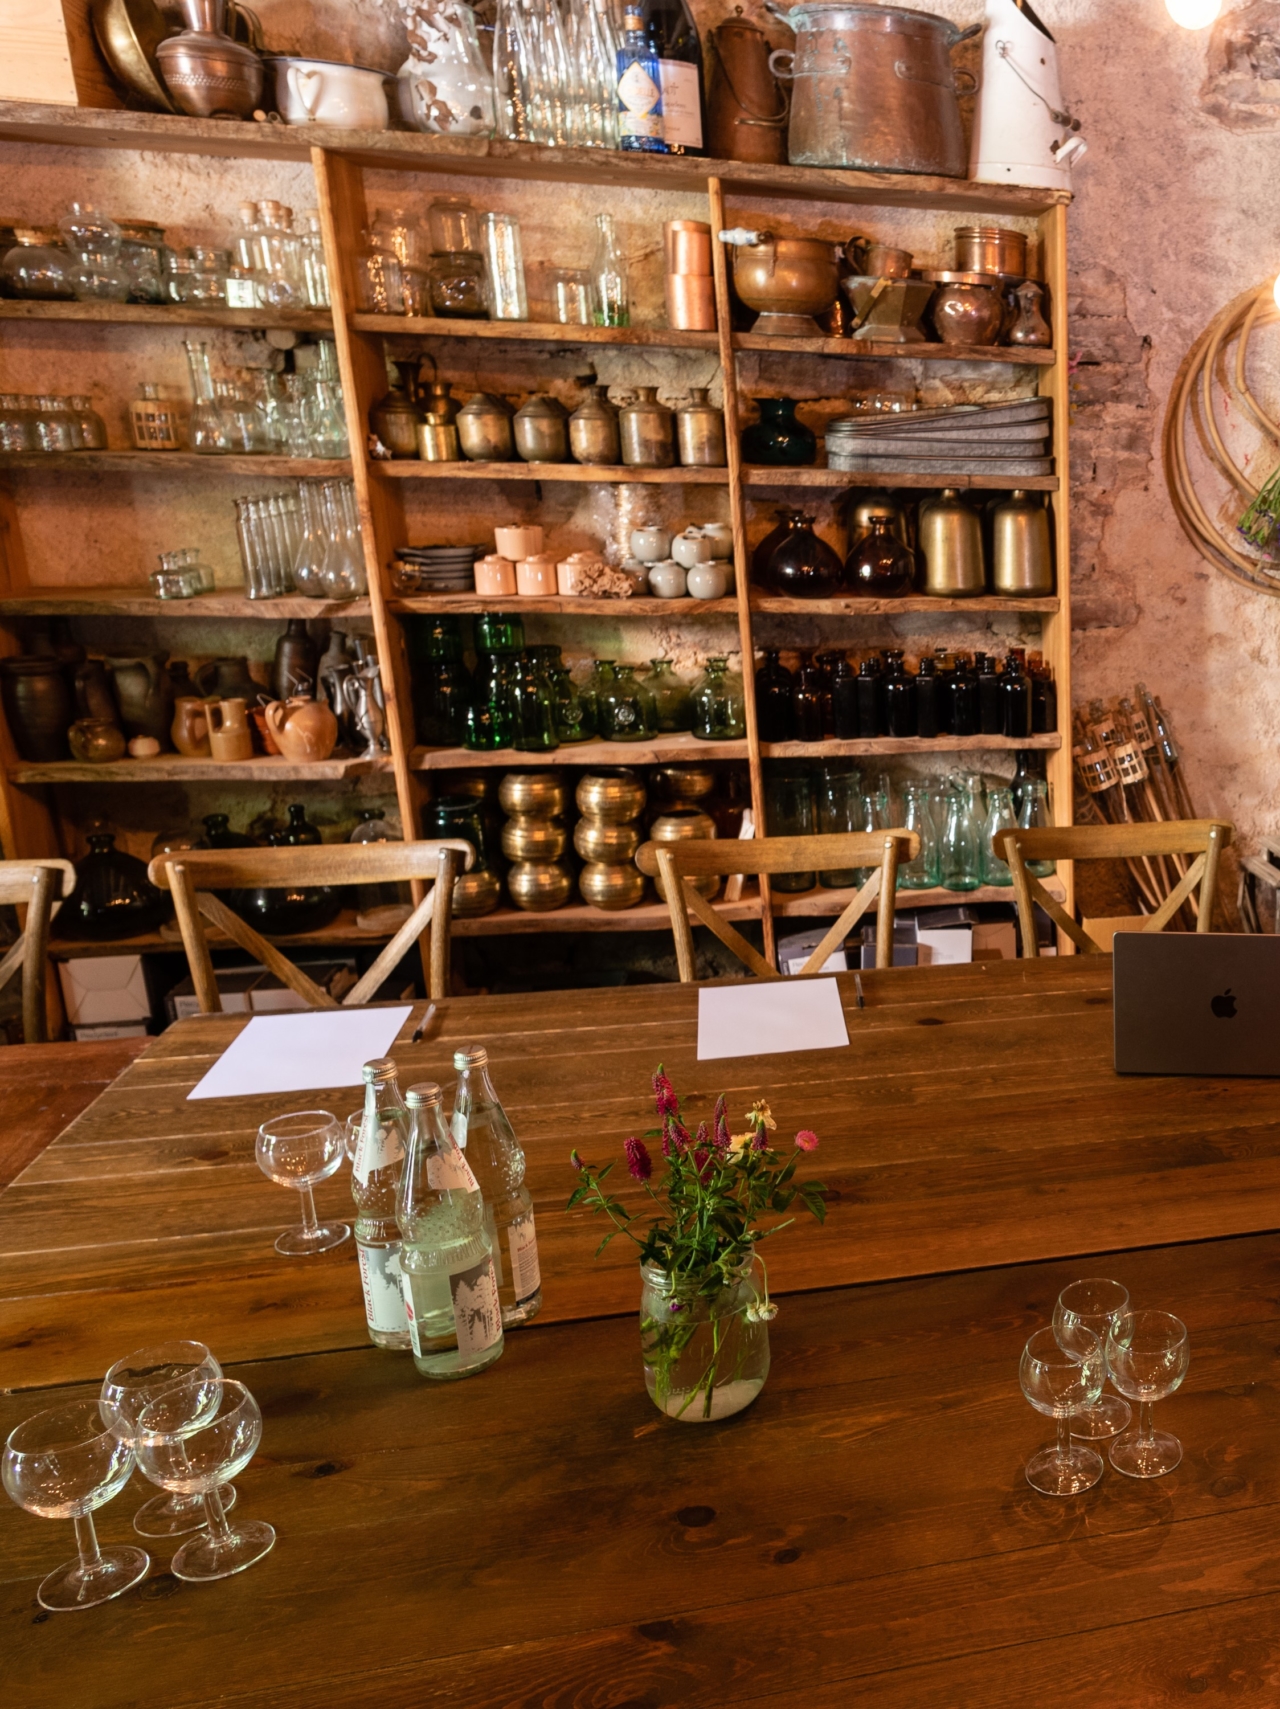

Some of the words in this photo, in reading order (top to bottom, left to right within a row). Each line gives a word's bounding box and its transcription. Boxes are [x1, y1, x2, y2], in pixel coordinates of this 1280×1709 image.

[354, 1145, 363, 1172] Black
[359, 1113, 369, 1143] Forest
[462, 1161, 474, 1187] Black
[358, 1247, 369, 1287] Forest
[364, 1289, 375, 1322] Black
